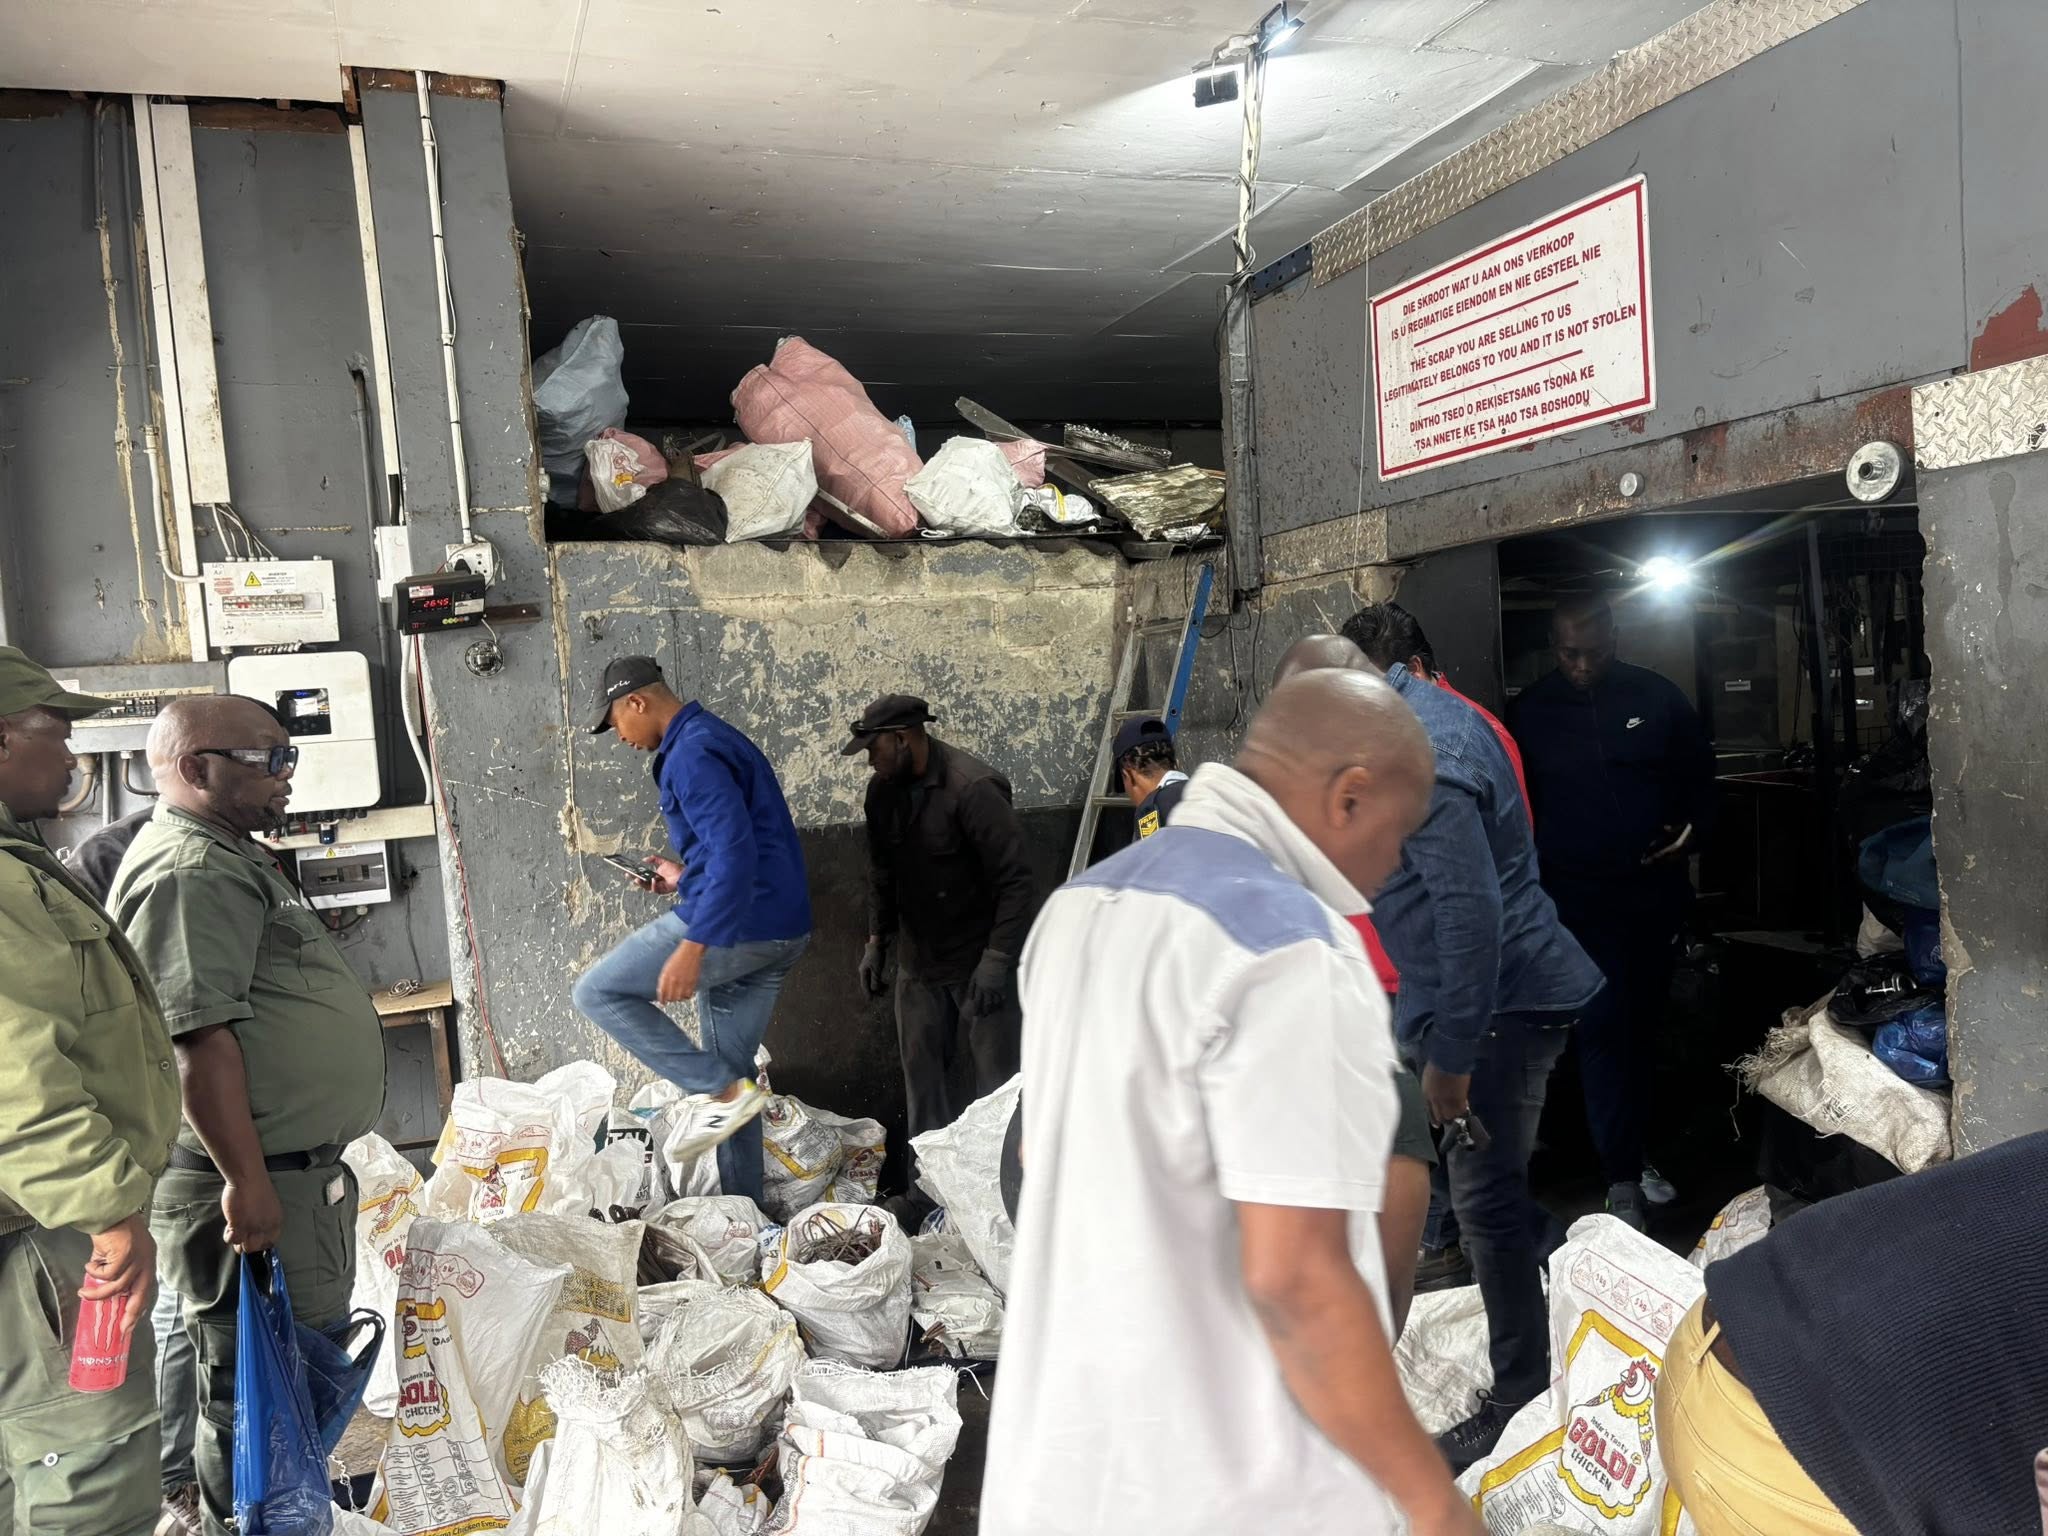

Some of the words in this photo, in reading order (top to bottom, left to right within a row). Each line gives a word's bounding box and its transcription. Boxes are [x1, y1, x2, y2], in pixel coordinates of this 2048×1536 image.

[1391, 329, 1399, 341] IS
[1400, 325, 1406, 337] U
[1408, 305, 1454, 333] REGMATIGE
[1456, 288, 1496, 314] EIENDOM
[1499, 282, 1512, 297] EN
[1515, 273, 1531, 290] NIE
[1534, 256, 1579, 282] GESTEEL
[1582, 245, 1601, 262] NIE
[1403, 302, 1416, 316] DIE
[1417, 286, 1450, 309] SKROOT
[1451, 277, 1470, 294] WAT
[1472, 273, 1479, 285] U
[1481, 265, 1501, 282] AAN
[1504, 255, 1524, 272] ONS
[1527, 232, 1574, 262] VERKOOP
[1385, 374, 1438, 402] LEGITIMATELY
[1440, 359, 1480, 382] BELONGS
[1482, 353, 1495, 366] TO
[1498, 348, 1517, 360] YOU
[1520, 338, 1540, 355] AND
[1543, 333, 1552, 346] IT
[1555, 329, 1565, 342] IS
[1568, 320, 1589, 338] NOT
[1592, 304, 1636, 329] STOLEN
[1411, 357, 1426, 371] THE
[1428, 347, 1455, 366] SCRAP
[1457, 340, 1475, 353] YOU
[1478, 332, 1496, 348] ARE
[1499, 316, 1539, 340] SELLING
[1541, 310, 1554, 323] TO
[1557, 303, 1571, 319] US
[1410, 414, 1440, 433] DINTHO
[1442, 406, 1465, 421] TSEO
[1467, 404, 1473, 415] O
[1476, 383, 1541, 412] REKISETSANG
[1543, 371, 1577, 390] TSONA
[1580, 365, 1595, 380] KE
[1416, 437, 1431, 451] TSA
[1433, 427, 1461, 445] NNETE
[1463, 423, 1476, 437] KE
[1478, 419, 1496, 432] TSA
[1498, 411, 1517, 426] HAO
[1520, 406, 1539, 419] TSA
[1541, 391, 1590, 414] BOSHODU
[1571, 1448, 1612, 1491] CHICKEN
